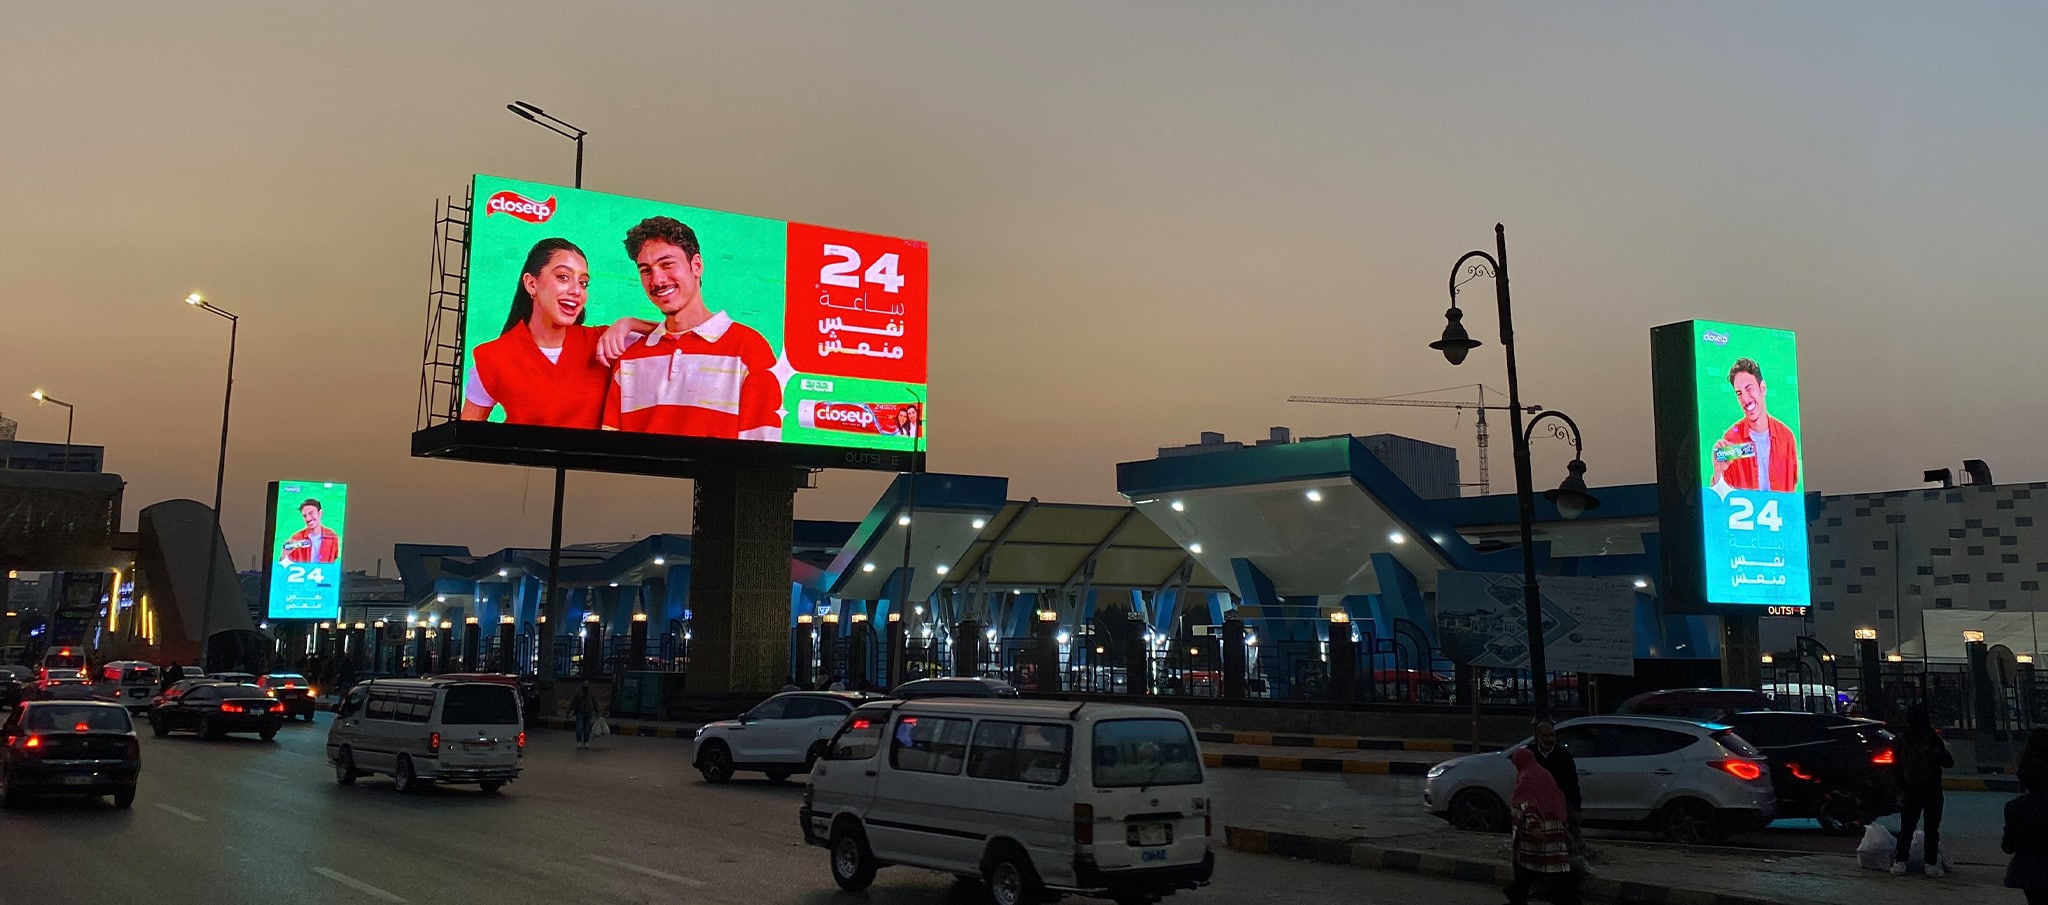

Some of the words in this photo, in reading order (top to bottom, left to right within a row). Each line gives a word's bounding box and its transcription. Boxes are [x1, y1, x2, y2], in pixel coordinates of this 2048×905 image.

[489, 196, 550, 219] closeup
[820, 243, 905, 293] 24
[819, 289, 905, 316] ساعة
[818, 315, 904, 337] نفس
[818, 331, 904, 360] منعش
[805, 380, 829, 392] جديد
[816, 406, 873, 428] closeup
[845, 452, 899, 466] OUTSIE
[1728, 497, 1783, 532] 24
[1730, 552, 1785, 569] نفس
[287, 565, 325, 584] 24
[1731, 566, 1787, 587] منعش
[1768, 605, 1807, 616] OUTSIE
